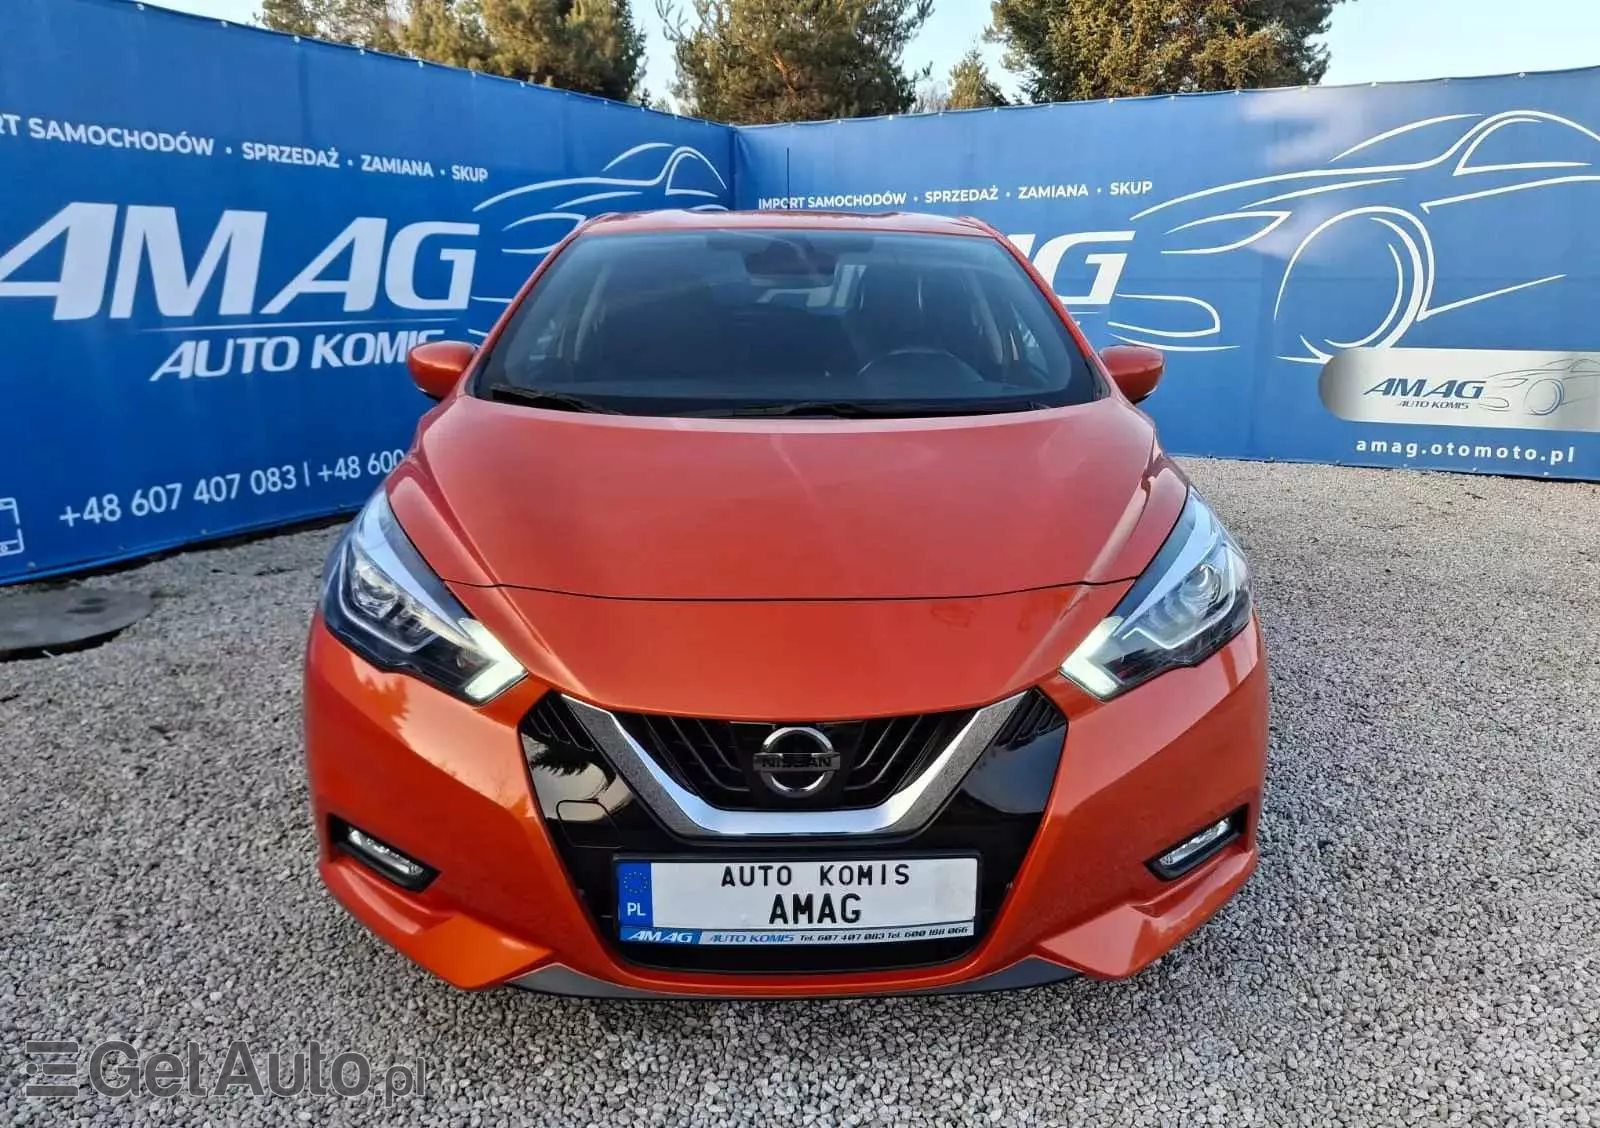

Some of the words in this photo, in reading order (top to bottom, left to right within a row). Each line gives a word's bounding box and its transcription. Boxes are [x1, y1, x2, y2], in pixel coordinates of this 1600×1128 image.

[28, 117, 214, 156] SAMOCHODÓW
[242, 142, 340, 169] SPRZEDAŻ
[361, 154, 434, 178] ZAMIANA
[451, 164, 488, 183] SKUP
[757, 196, 805, 210] IMPORT
[807, 189, 907, 208] SAMOCHODÓW
[924, 185, 999, 204] SPRZEDAŻ
[1018, 184, 1089, 200] ZAMIANA
[1109, 180, 1153, 196] SKUP
[150, 335, 299, 382] AUTO
[1363, 377, 1487, 400] AMAG
[1398, 400, 1429, 409] AUTO
[1431, 401, 1470, 410] KOMIS
[1356, 438, 1574, 466] amag.otomoto.pl
[59, 494, 122, 528] +48
[131, 483, 183, 517] 607
[193, 473, 241, 505] 407
[250, 464, 297, 495] 083
[317, 455, 361, 482] +48
[761, 757, 832, 768] NISSAN
[721, 866, 793, 887] AUTO
[819, 864, 911, 886] KOMIS
[627, 902, 647, 917] PL
[768, 894, 862, 925] AMAG
[628, 930, 694, 943] AMAG
[709, 934, 746, 943] AUTO
[750, 933, 796, 942] KOMIS
[817, 934, 838, 942] 607
